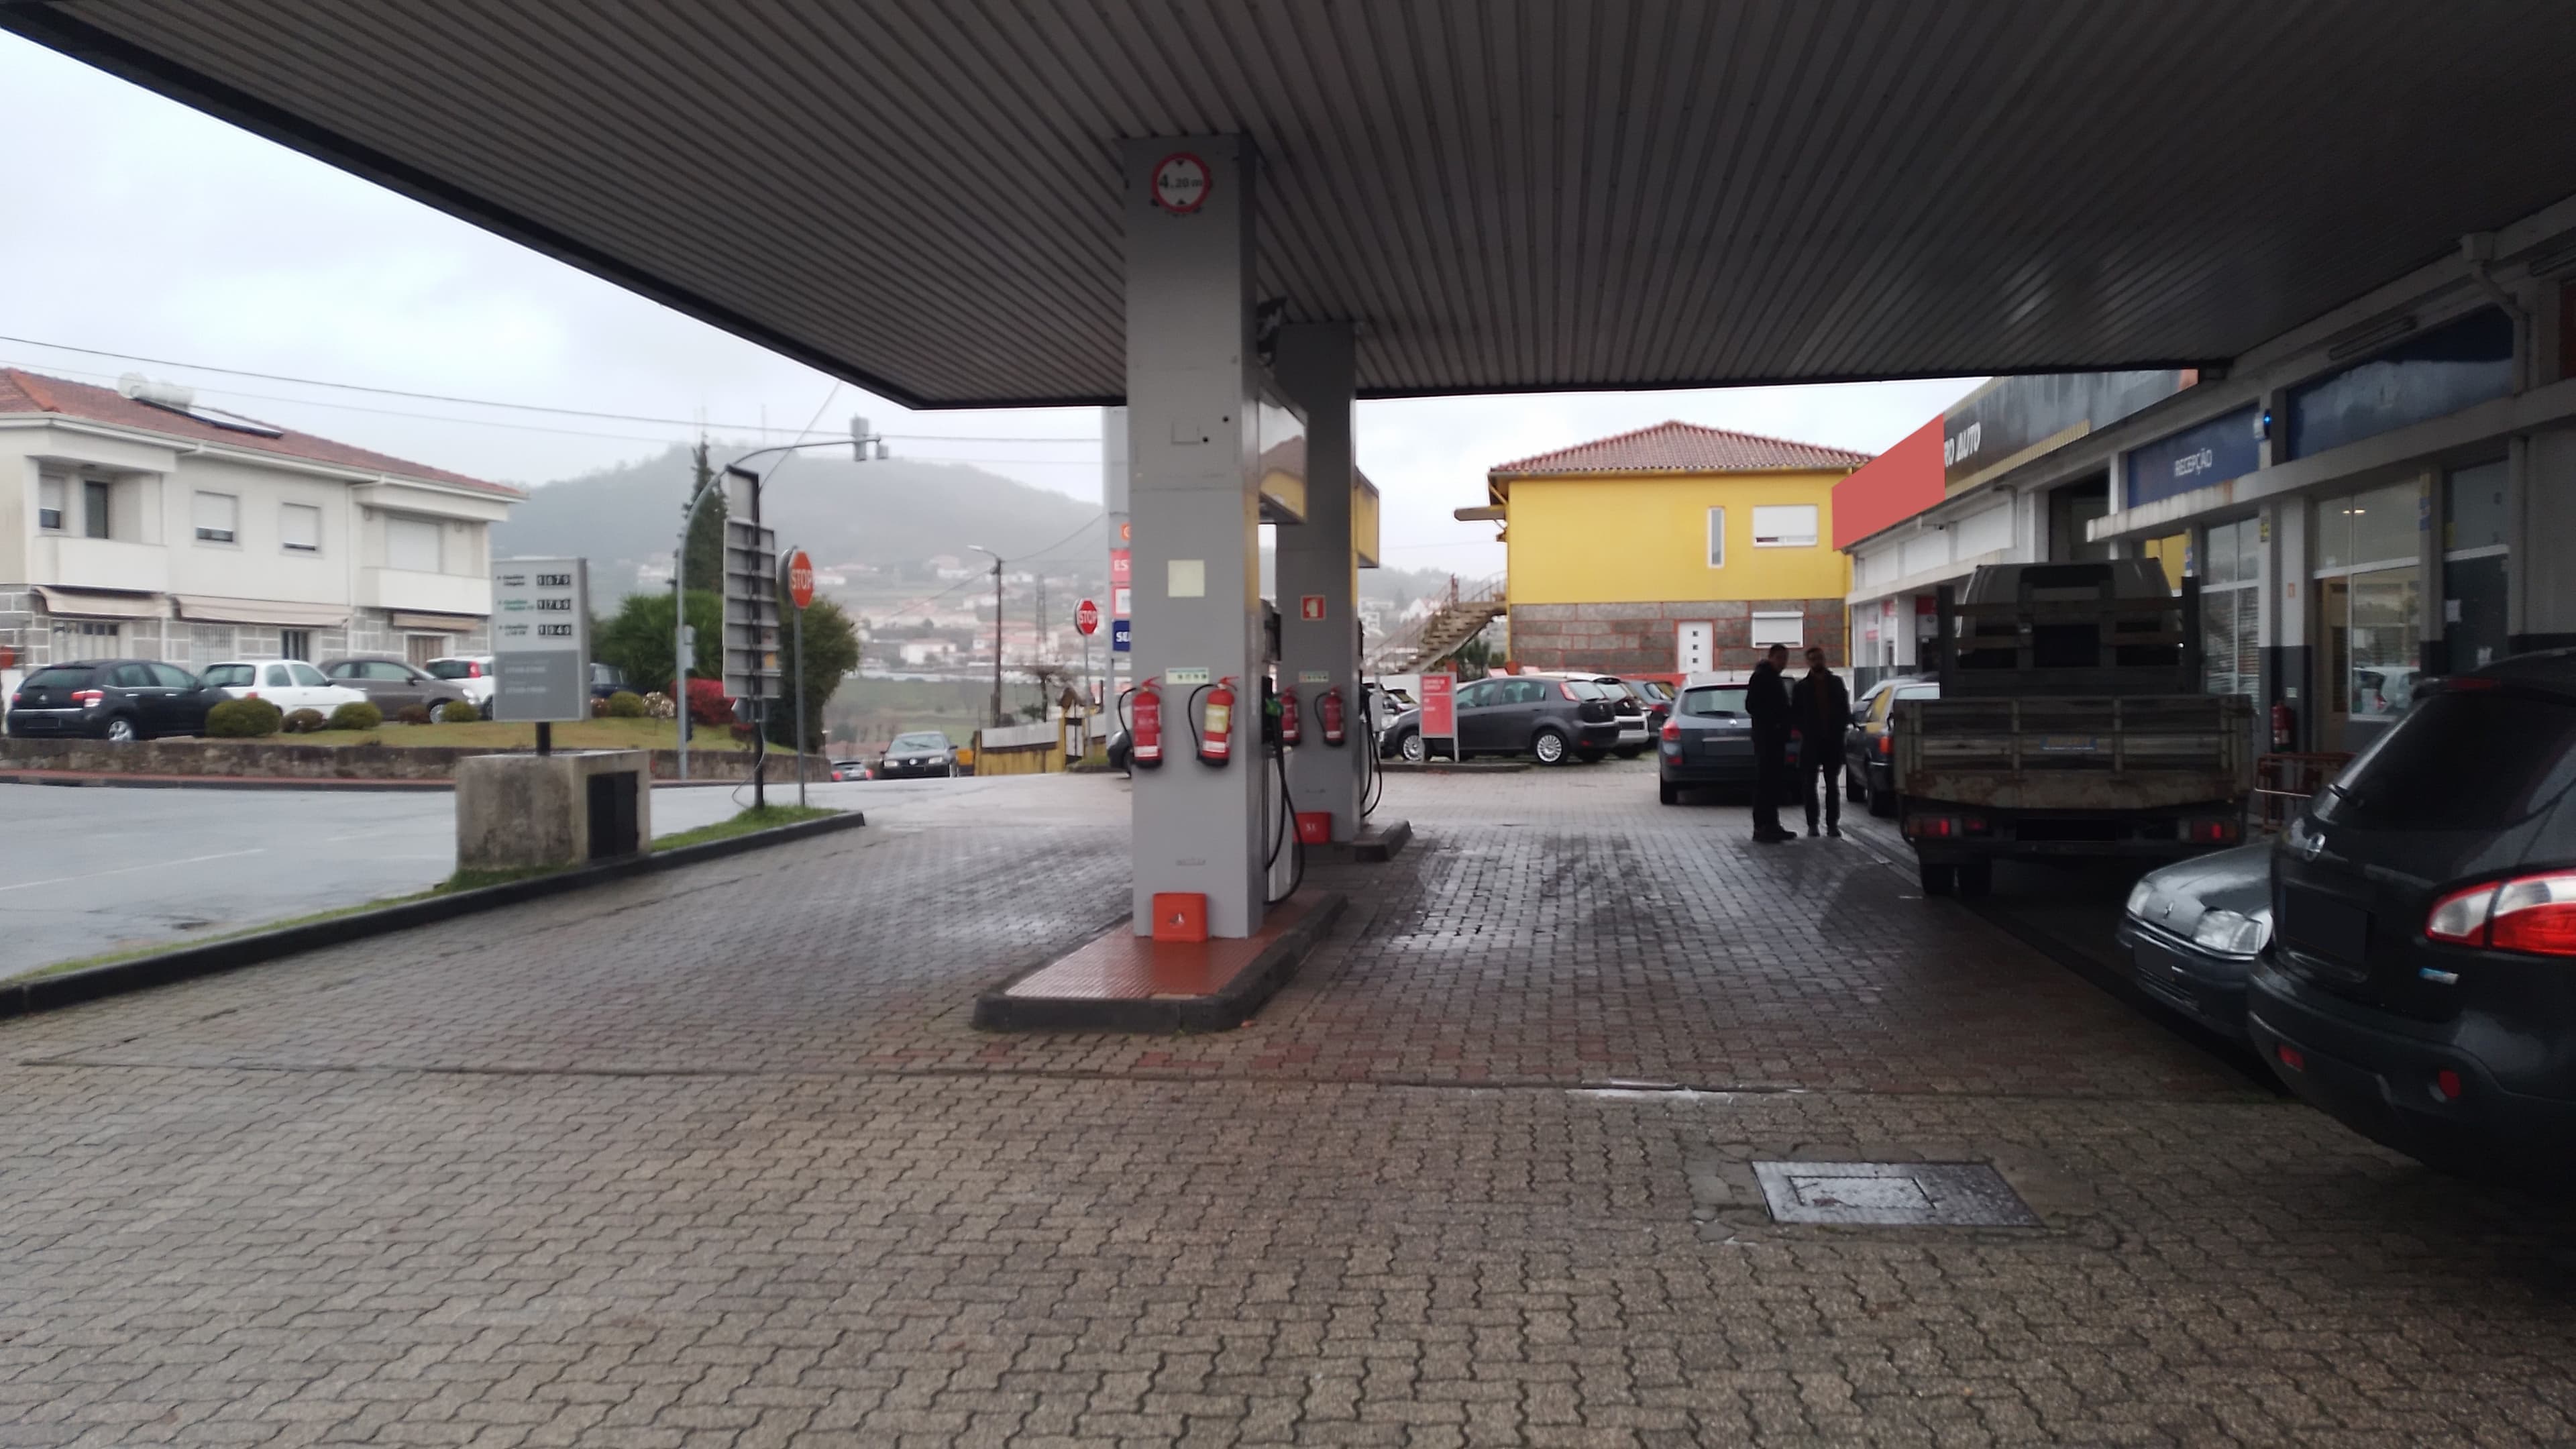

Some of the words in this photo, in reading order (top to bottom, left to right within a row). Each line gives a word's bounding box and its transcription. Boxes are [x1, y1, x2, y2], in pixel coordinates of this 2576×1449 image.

[1955, 421, 1981, 462] AUTO
[2174, 447, 2212, 478] RECEPÇÃO
[791, 568, 812, 590] STOP
[1078, 610, 1097, 625] STOP
